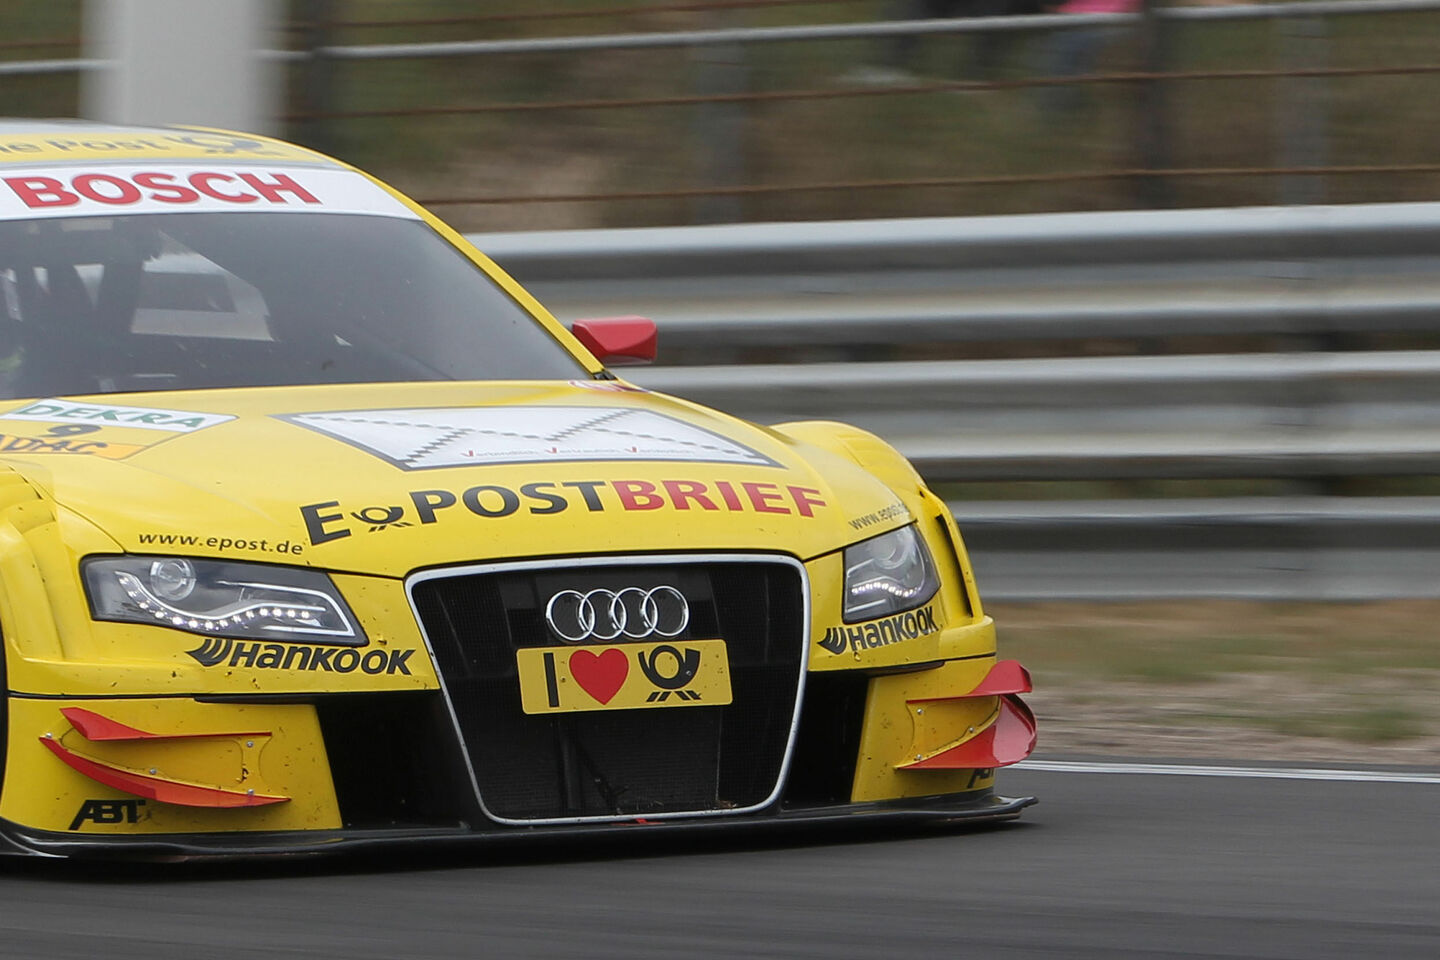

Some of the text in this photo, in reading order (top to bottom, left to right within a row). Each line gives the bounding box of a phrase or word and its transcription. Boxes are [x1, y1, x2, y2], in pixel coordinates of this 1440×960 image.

[45, 138, 172, 152] Post
[0, 172, 323, 209] BOSCH
[14, 404, 206, 428] DEKRA
[42, 424, 103, 437] 9
[409, 479, 827, 525] POSTBRIEF
[139, 534, 304, 555] www.epost.de
[68, 799, 147, 831] ABT
